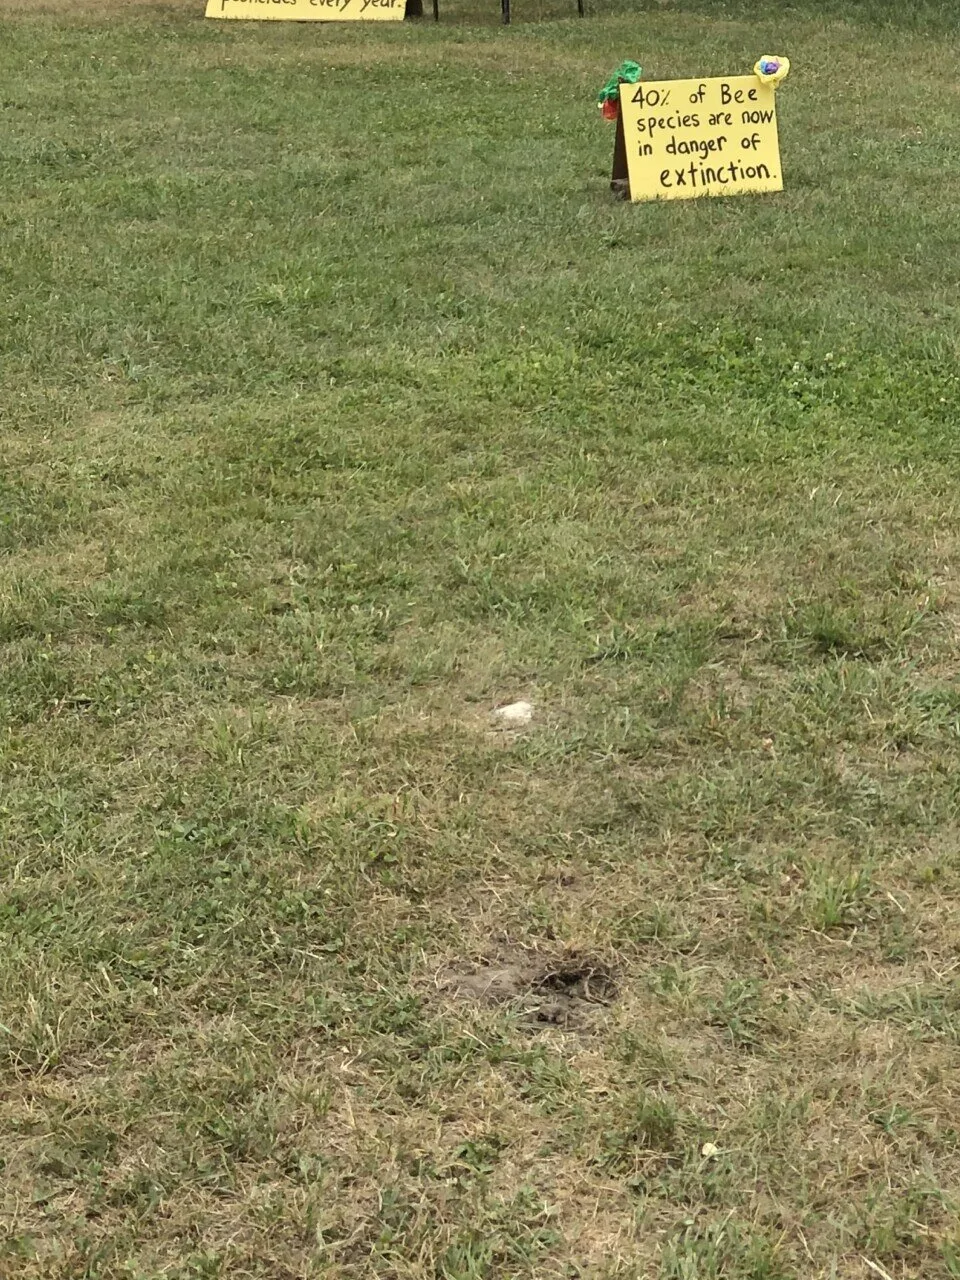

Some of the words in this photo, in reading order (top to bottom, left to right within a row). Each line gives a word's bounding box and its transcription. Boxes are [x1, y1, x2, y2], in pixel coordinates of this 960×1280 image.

[631, 86, 671, 109] 40%
[689, 83, 706, 104] of
[721, 83, 757, 104] Bee
[637, 110, 700, 137] species
[708, 111, 733, 126] are
[742, 109, 773, 124] now
[638, 141, 652, 156] in
[666, 135, 727, 159] danger
[741, 133, 760, 150] of
[660, 159, 777, 187] extinction.
